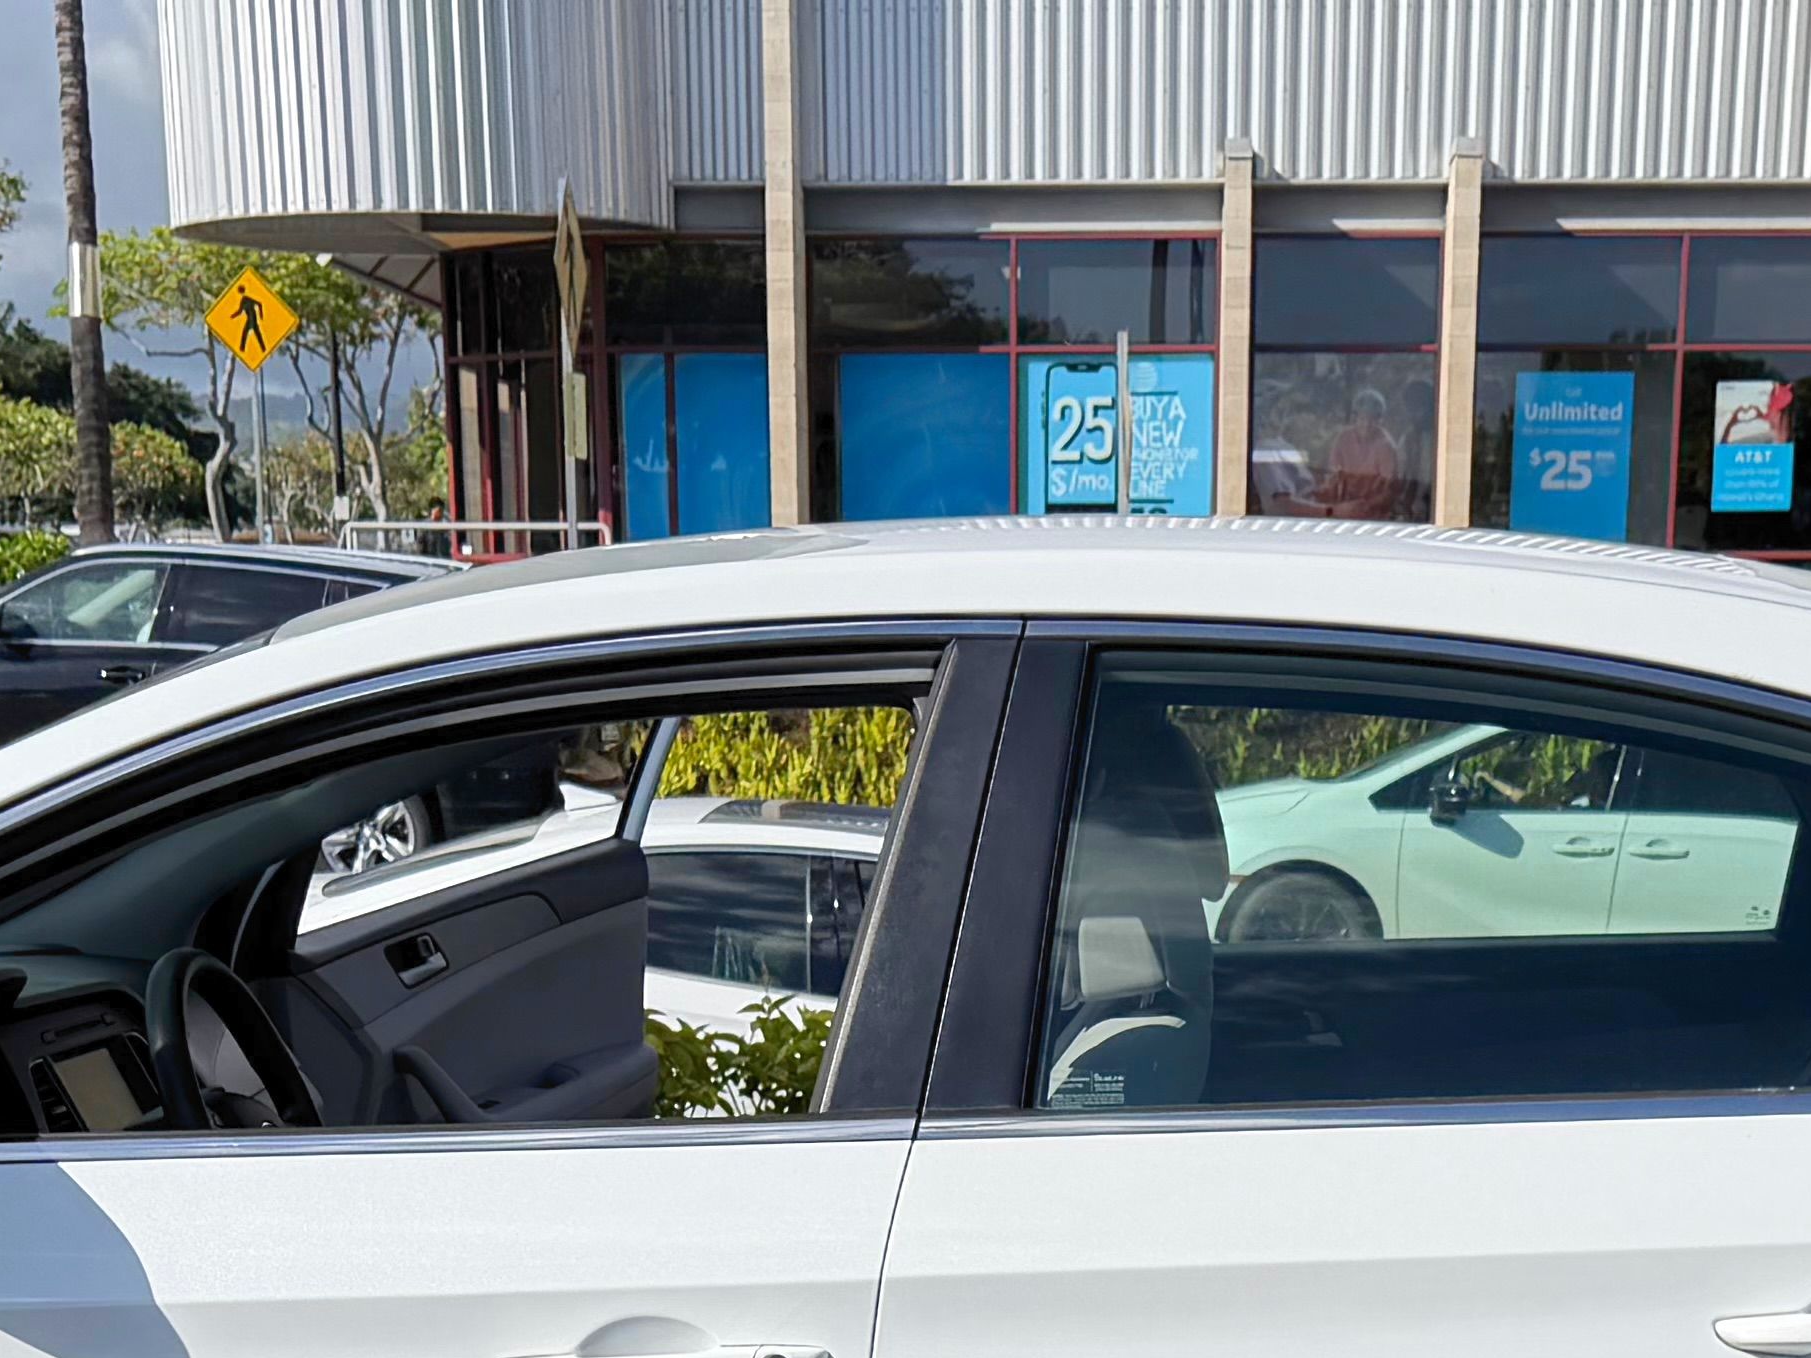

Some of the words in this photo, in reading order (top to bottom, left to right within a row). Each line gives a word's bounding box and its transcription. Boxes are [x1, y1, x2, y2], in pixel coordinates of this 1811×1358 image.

[1130, 396, 1169, 419] BUY
[1169, 396, 1187, 420] A
[1524, 401, 1624, 421] Unlimited
[1051, 395, 1114, 463] 25
[1131, 420, 1184, 447] NEW
[1735, 450, 1773, 464] AT&T
[1131, 461, 1188, 480] EVERY
